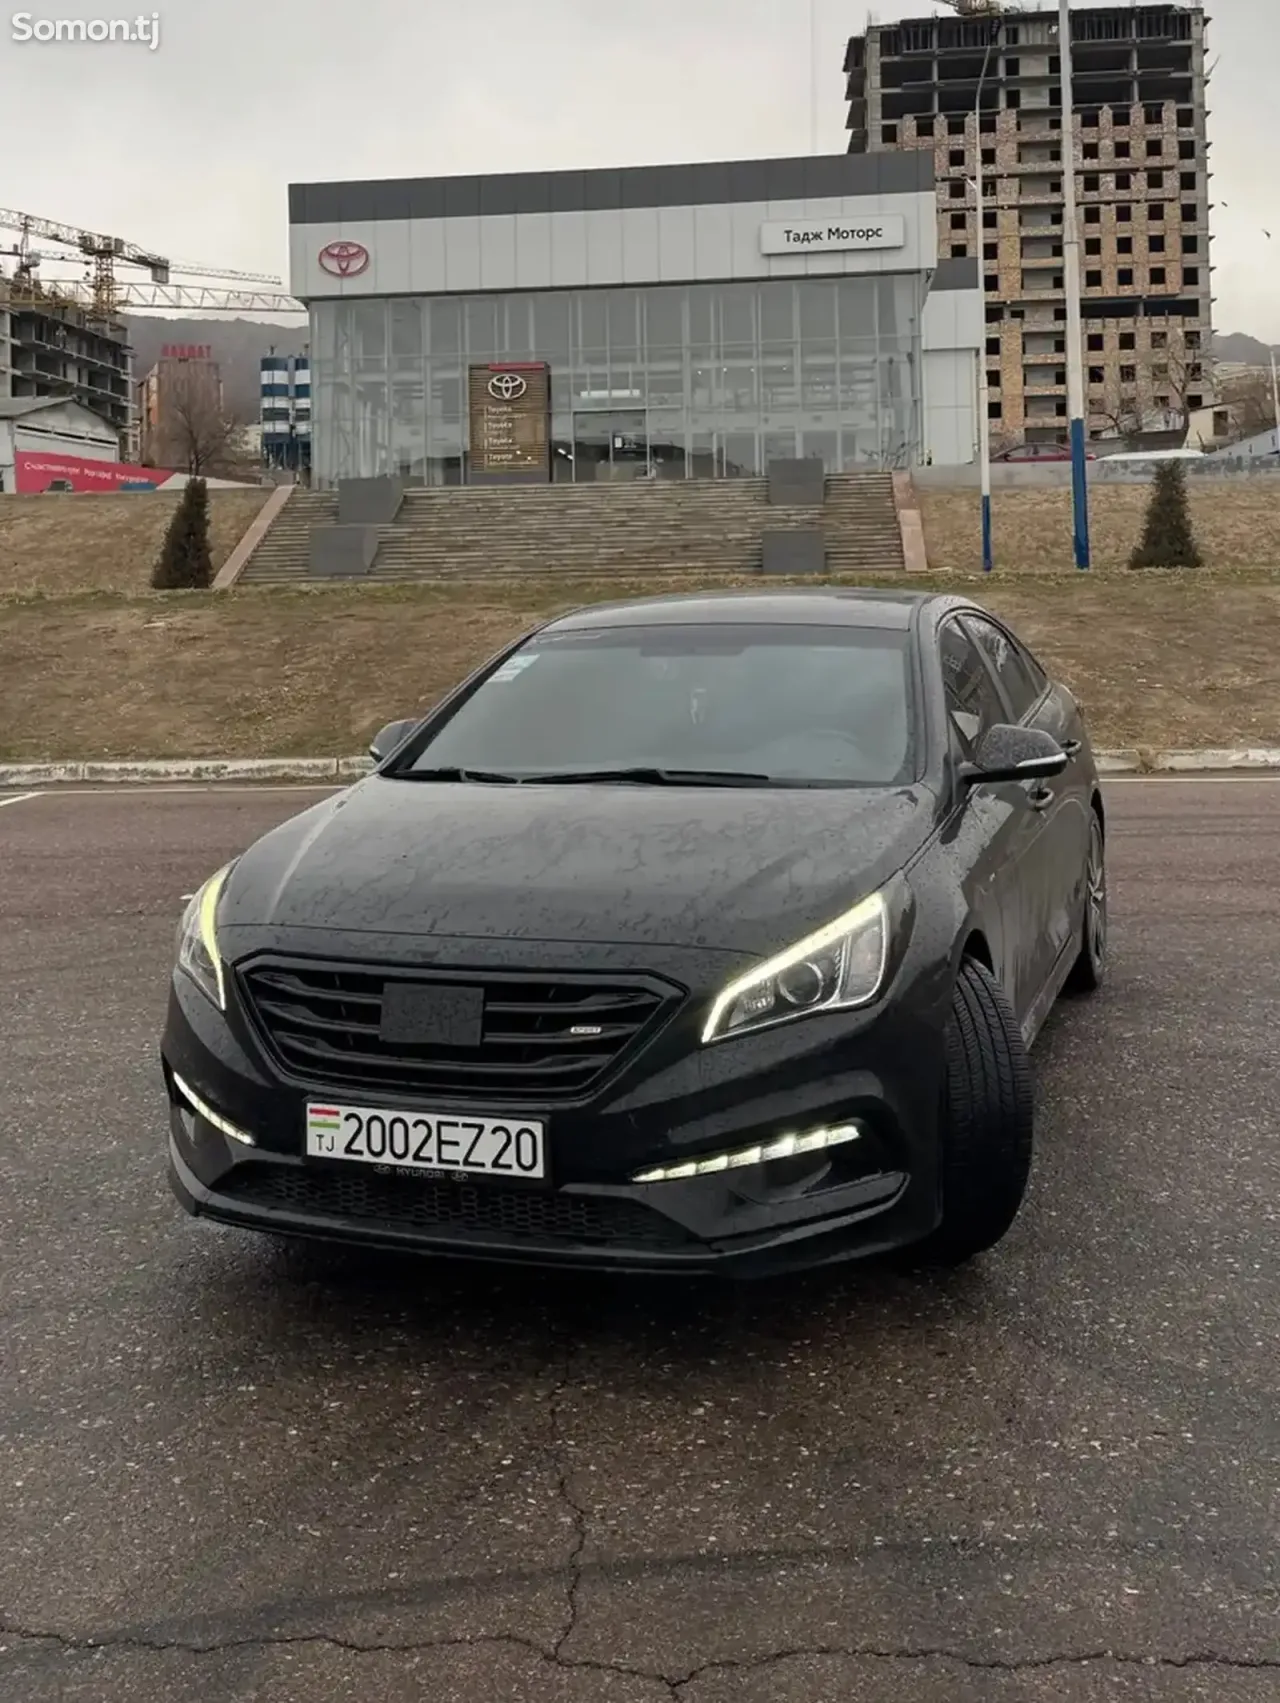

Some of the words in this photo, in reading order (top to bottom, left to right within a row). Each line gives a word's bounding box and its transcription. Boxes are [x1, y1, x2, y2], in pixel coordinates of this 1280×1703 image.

[784, 229, 823, 244] Тадж
[827, 227, 882, 241] Моторс
[316, 1134, 335, 1152] TJ
[343, 1112, 538, 1172] 2002EZ20
[396, 1167, 445, 1179] HYUNDAI
